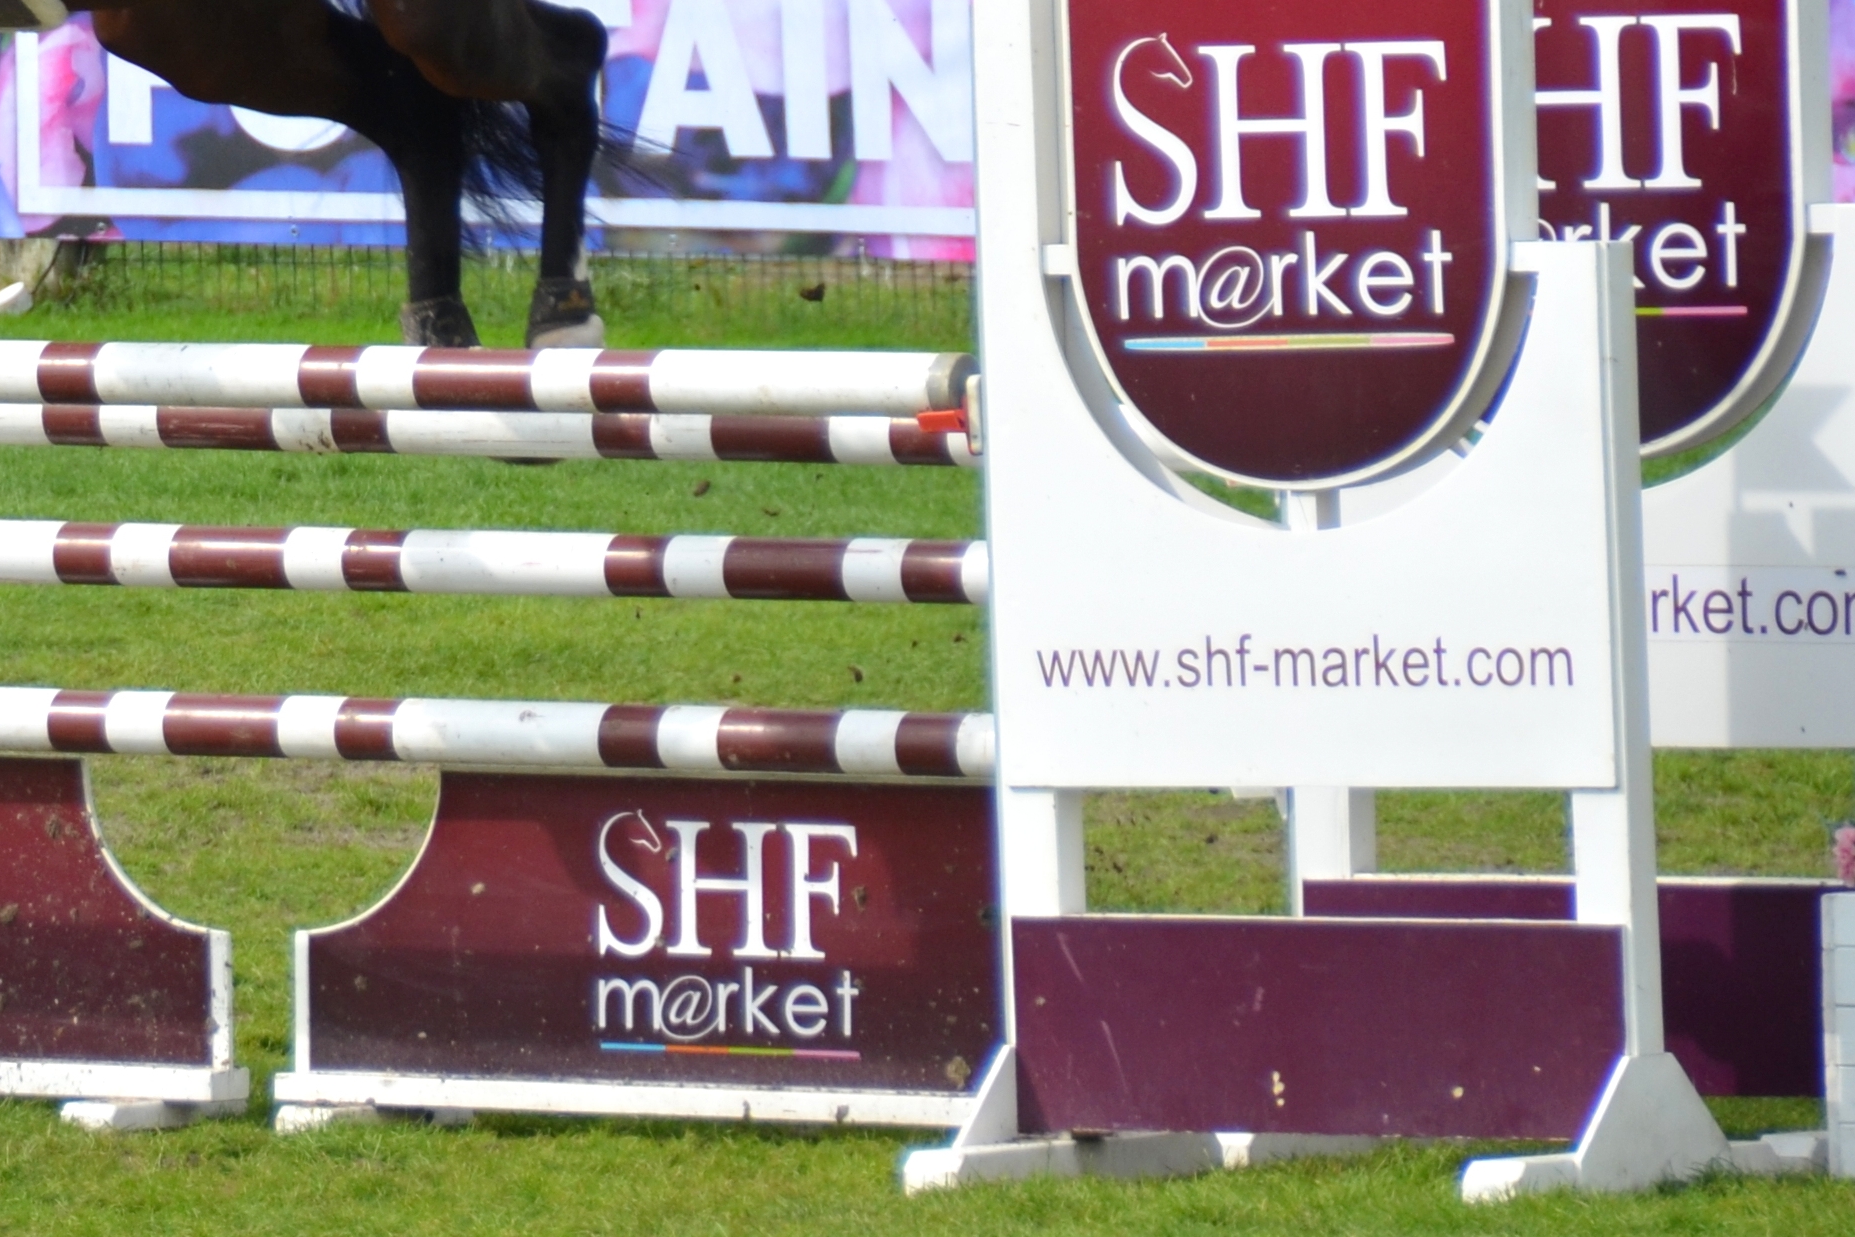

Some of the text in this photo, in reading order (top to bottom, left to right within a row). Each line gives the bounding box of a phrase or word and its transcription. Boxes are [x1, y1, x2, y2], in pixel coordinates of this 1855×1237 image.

[1112, 32, 1447, 226] SHF
[1117, 228, 1453, 329] m@rket
[1650, 573, 1855, 637] rket.co
[1036, 633, 1575, 689] www.shf-market.com
[598, 808, 859, 960] SHF
[597, 965, 860, 1041] m@rket
